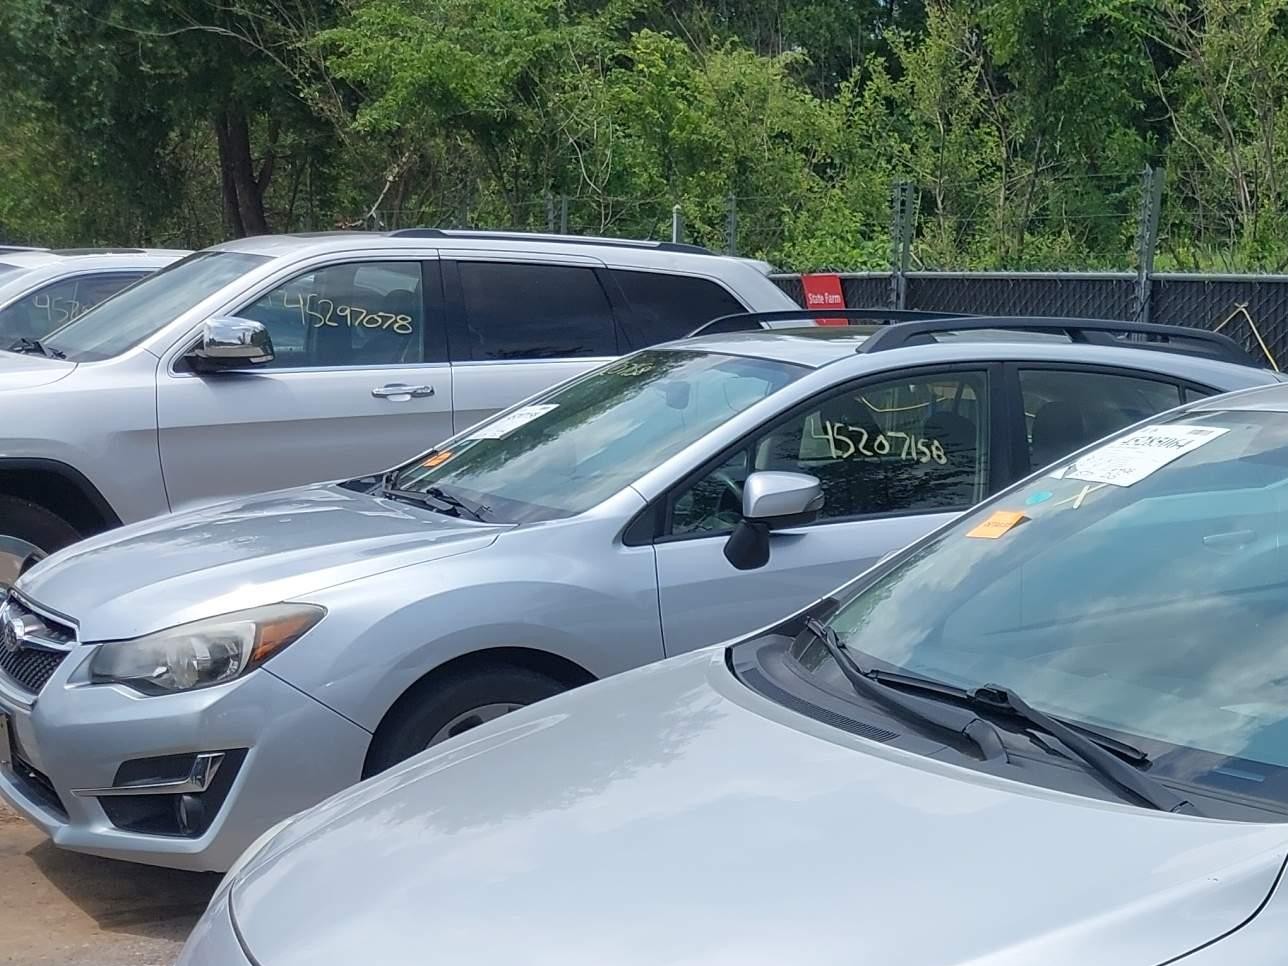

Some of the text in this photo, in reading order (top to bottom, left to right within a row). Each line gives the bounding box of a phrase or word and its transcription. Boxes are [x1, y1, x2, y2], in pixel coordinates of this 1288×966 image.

[282, 290, 413, 334] 45297078
[808, 292, 841, 304] State Farm
[811, 416, 948, 465] 45207158
